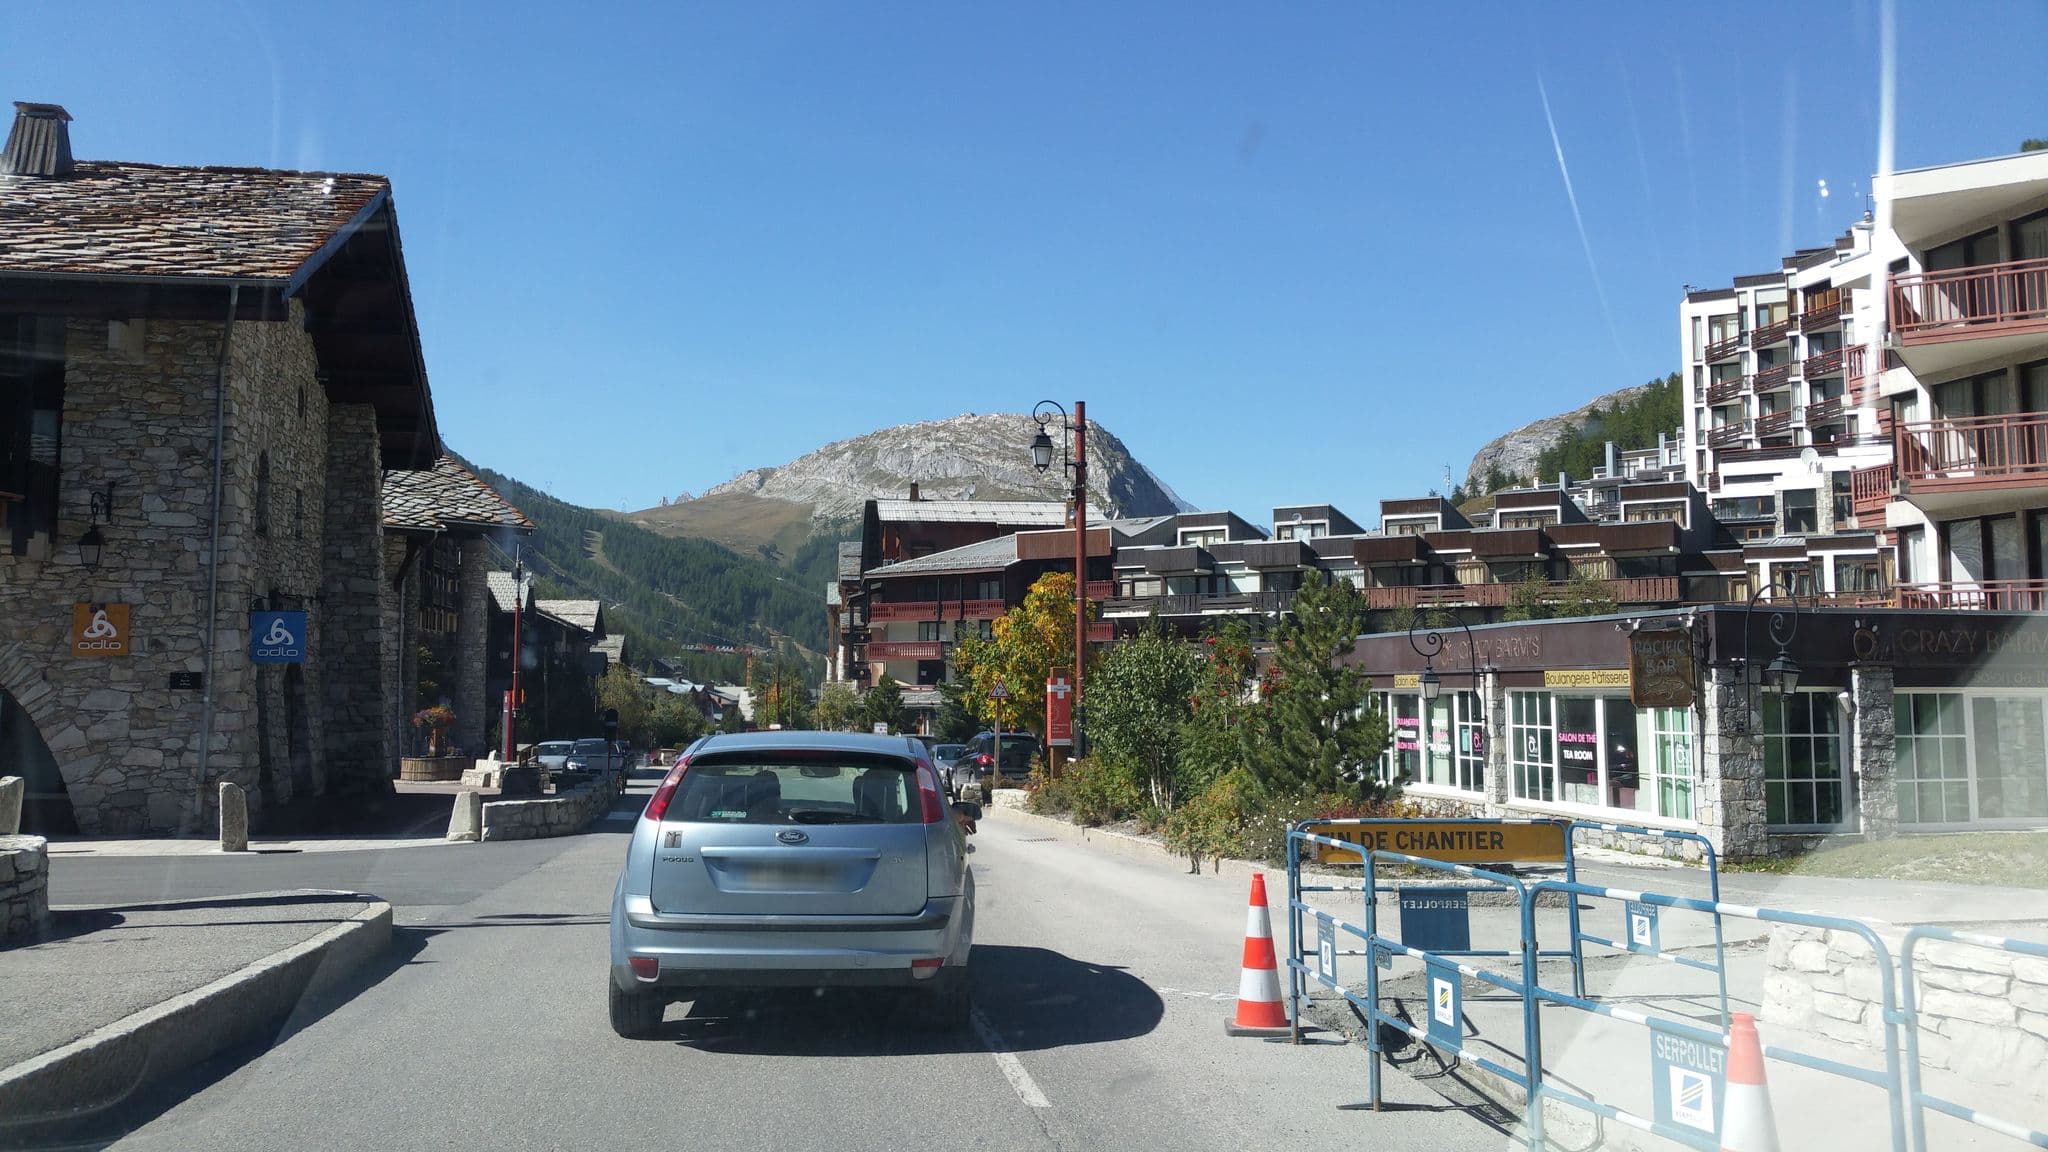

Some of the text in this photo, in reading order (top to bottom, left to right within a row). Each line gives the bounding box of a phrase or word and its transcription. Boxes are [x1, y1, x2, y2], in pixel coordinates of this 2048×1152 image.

[78, 641, 121, 650] odlo
[1633, 639, 1687, 656] PACIFIC
[1900, 629, 1977, 654] CRAZY
[257, 648, 298, 657] odlo
[1646, 658, 1676, 674] BAR
[1545, 671, 1629, 687] Boulangerie Pâtisserie
[1558, 733, 1577, 742] SALON
[1578, 733, 1586, 743] DE
[1563, 749, 1593, 760] TEA ROOM
[782, 832, 801, 840] Ford
[1360, 831, 1387, 850] DE
[1395, 831, 1504, 850] CHANTIER
[1656, 1034, 1724, 1073] SERPOLLET
